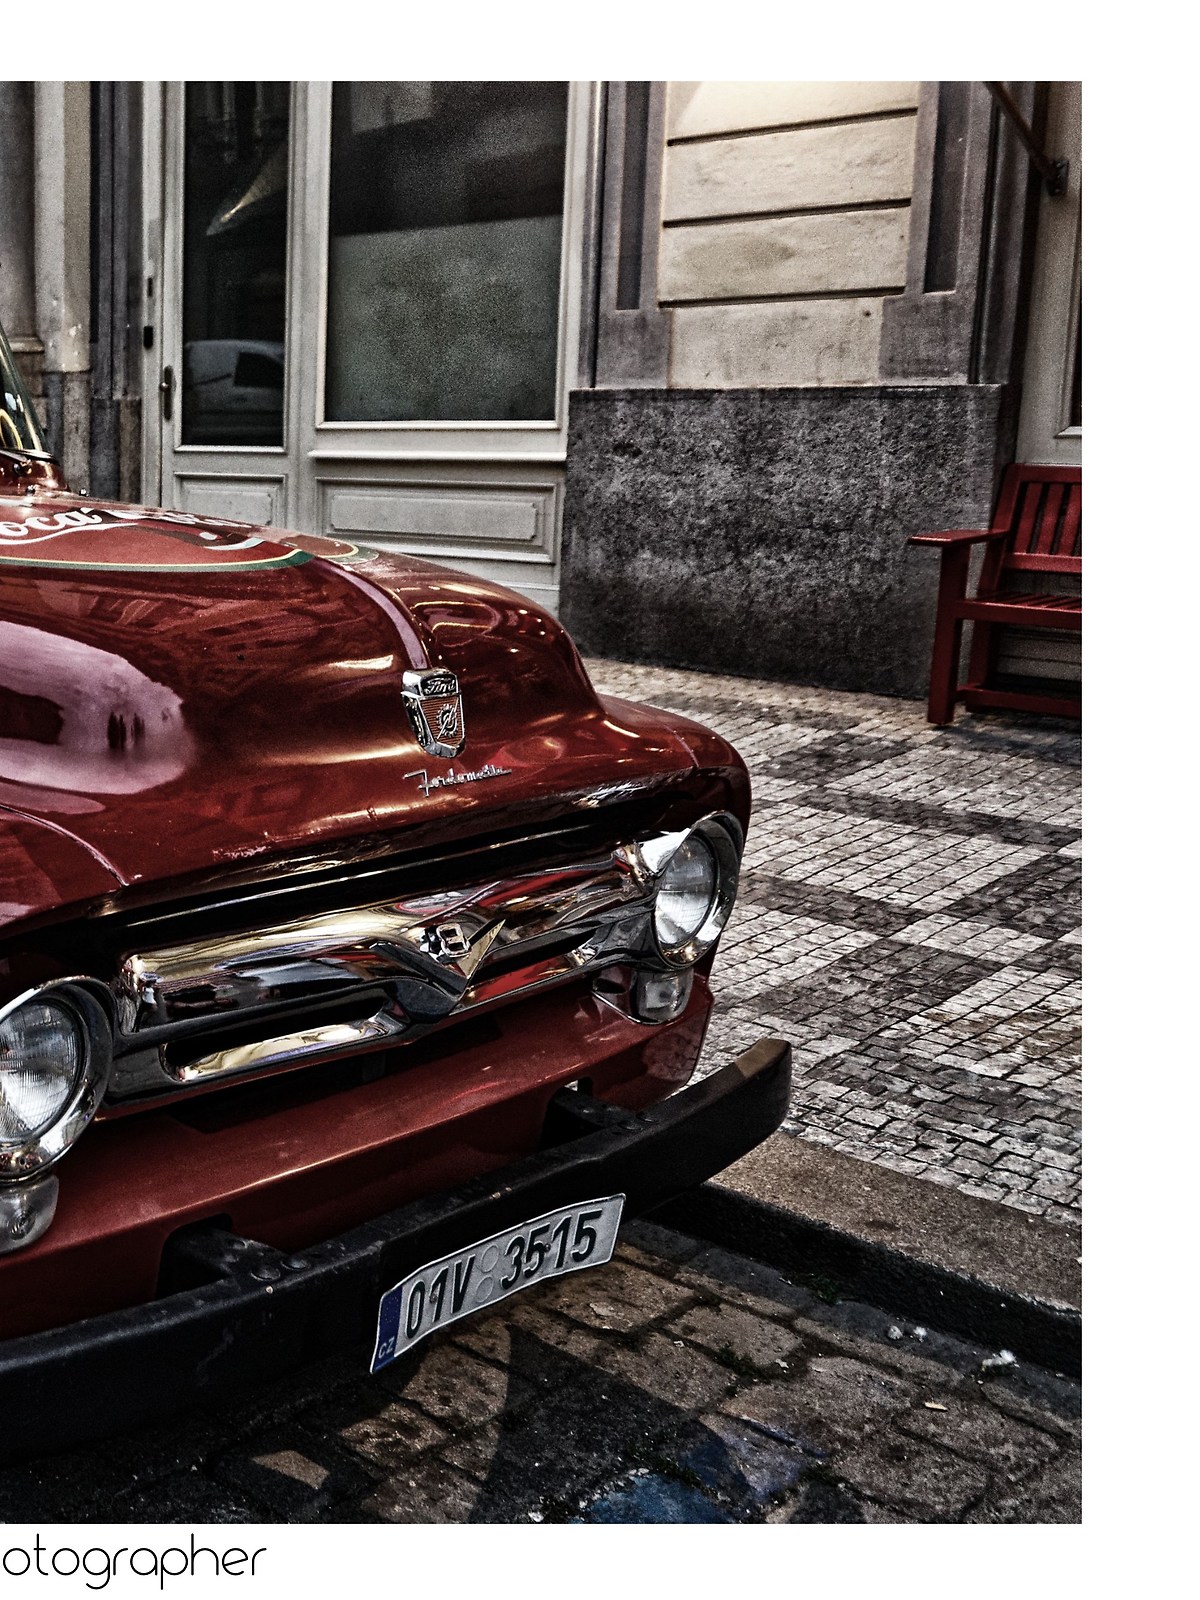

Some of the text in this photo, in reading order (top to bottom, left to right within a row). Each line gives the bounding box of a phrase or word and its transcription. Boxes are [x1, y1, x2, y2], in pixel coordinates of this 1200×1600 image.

[424, 676, 456, 695] Ford
[404, 1208, 603, 1340] 01V 3515
[378, 1336, 396, 1360] CZ
